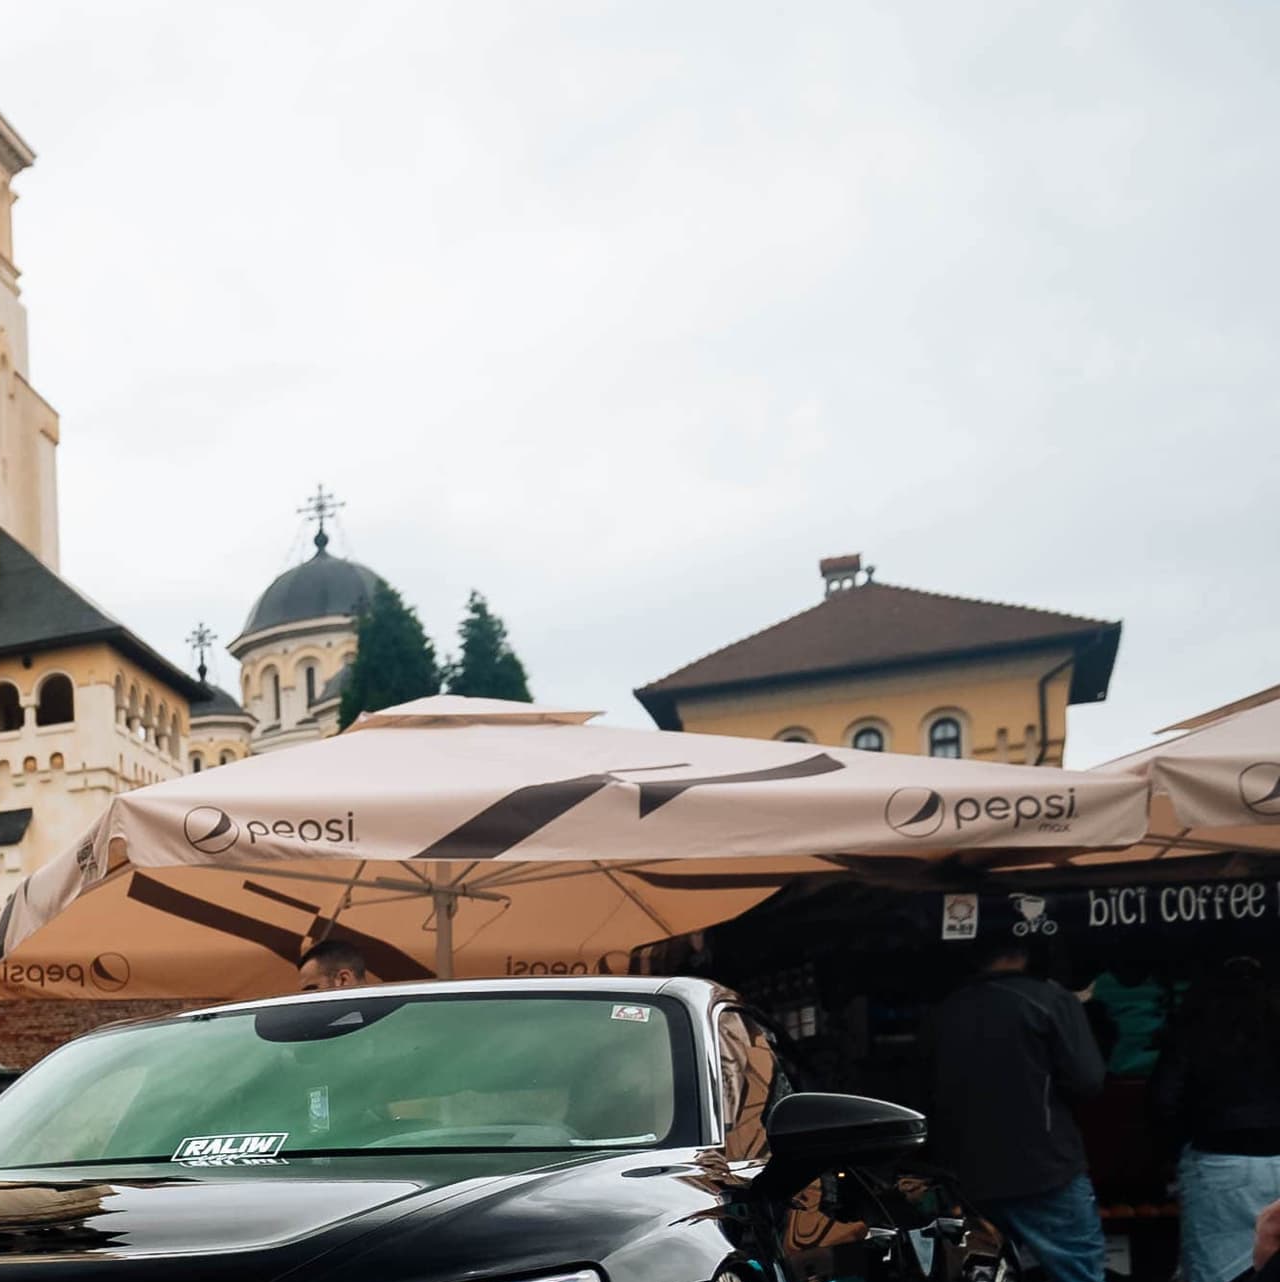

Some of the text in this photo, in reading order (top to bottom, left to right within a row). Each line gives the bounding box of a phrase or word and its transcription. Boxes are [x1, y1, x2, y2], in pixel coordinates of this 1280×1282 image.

[954, 788, 1076, 829] pepsi
[246, 811, 355, 845] pepsi
[1038, 822, 1072, 833] max
[1160, 882, 1266, 923] coffee
[182, 1136, 278, 1156] RALIW
